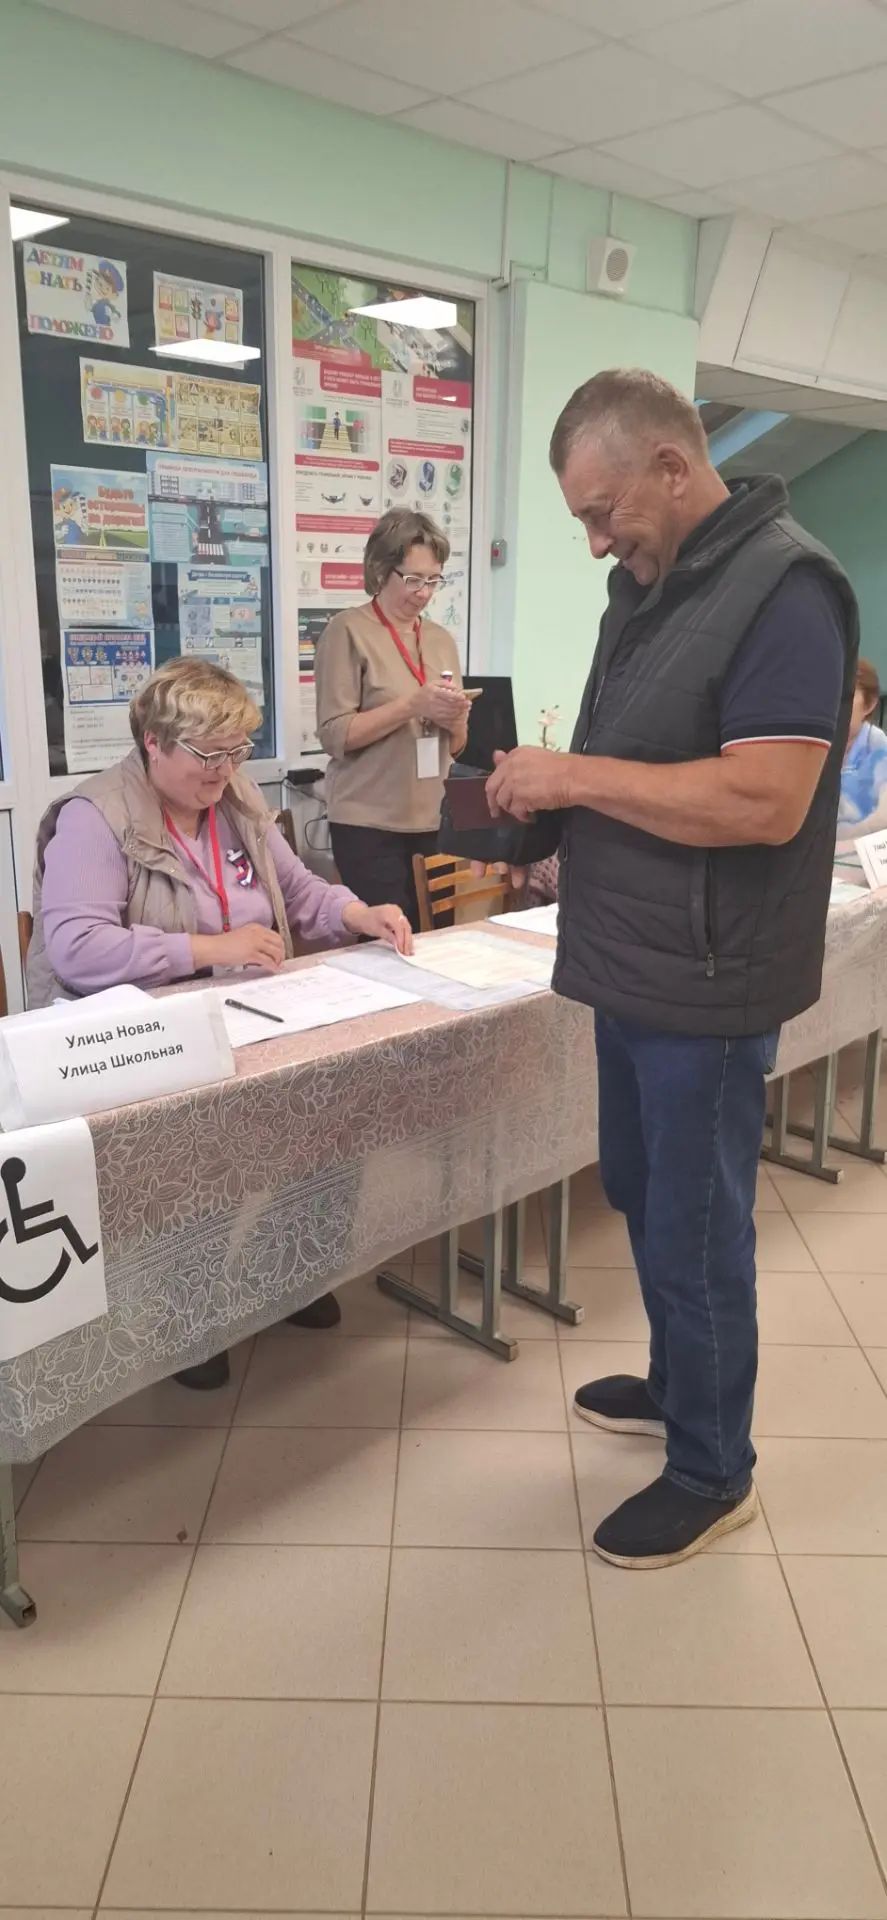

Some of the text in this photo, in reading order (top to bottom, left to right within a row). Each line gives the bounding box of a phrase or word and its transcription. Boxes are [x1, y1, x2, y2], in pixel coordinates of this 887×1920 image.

[29, 314, 114, 340] ПОЛОЖЕНО
[65, 1020, 165, 1049] Улица Новая,
[59, 1043, 184, 1080] Улица Школьная
